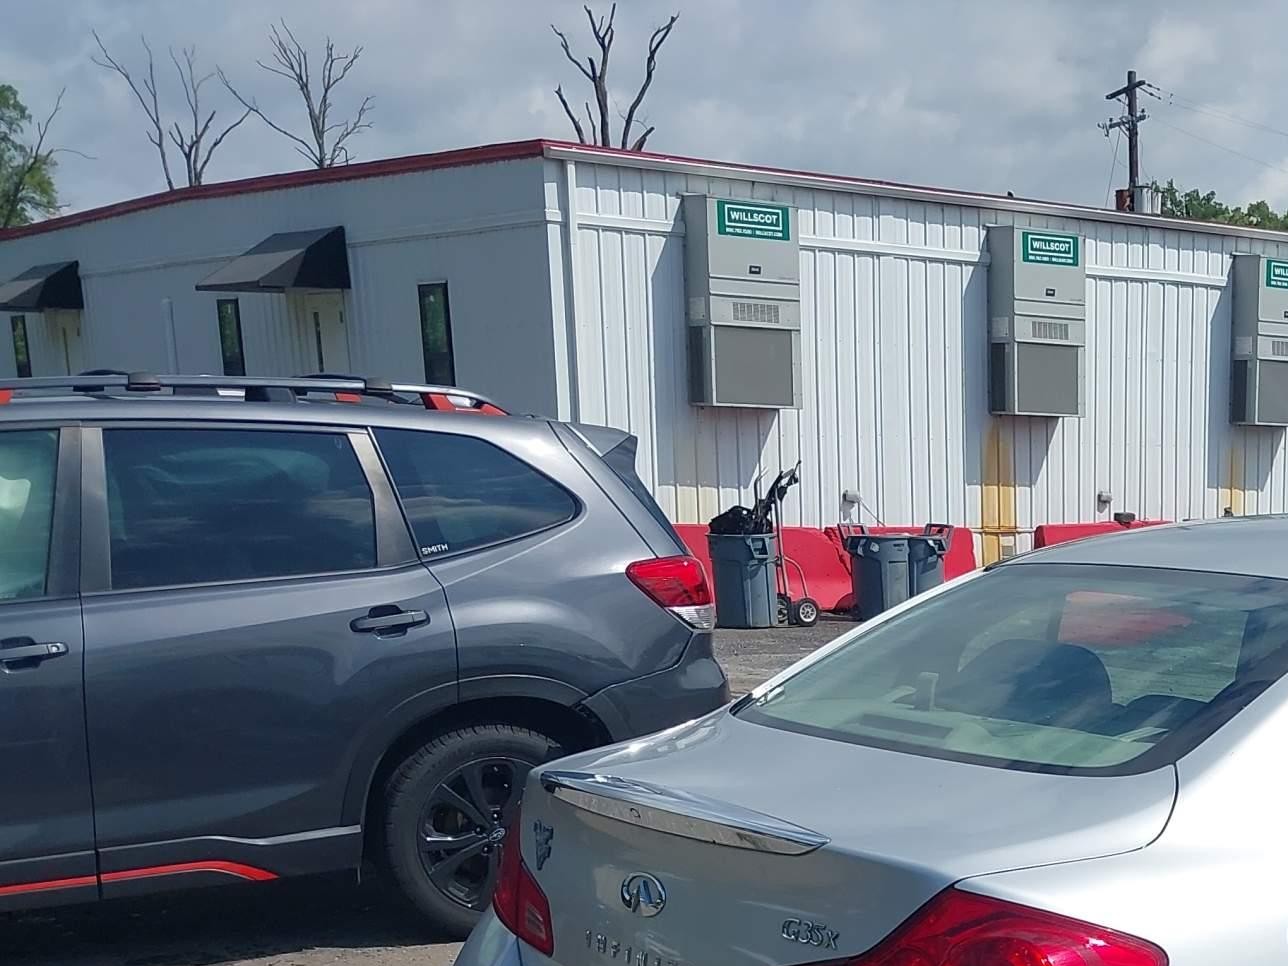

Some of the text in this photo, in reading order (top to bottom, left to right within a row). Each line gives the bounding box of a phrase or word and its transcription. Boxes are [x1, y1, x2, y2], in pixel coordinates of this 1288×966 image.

[730, 210, 778, 224] WILLSCOT
[1032, 240, 1070, 252] WILLSCOT
[421, 543, 449, 555] SMITH
